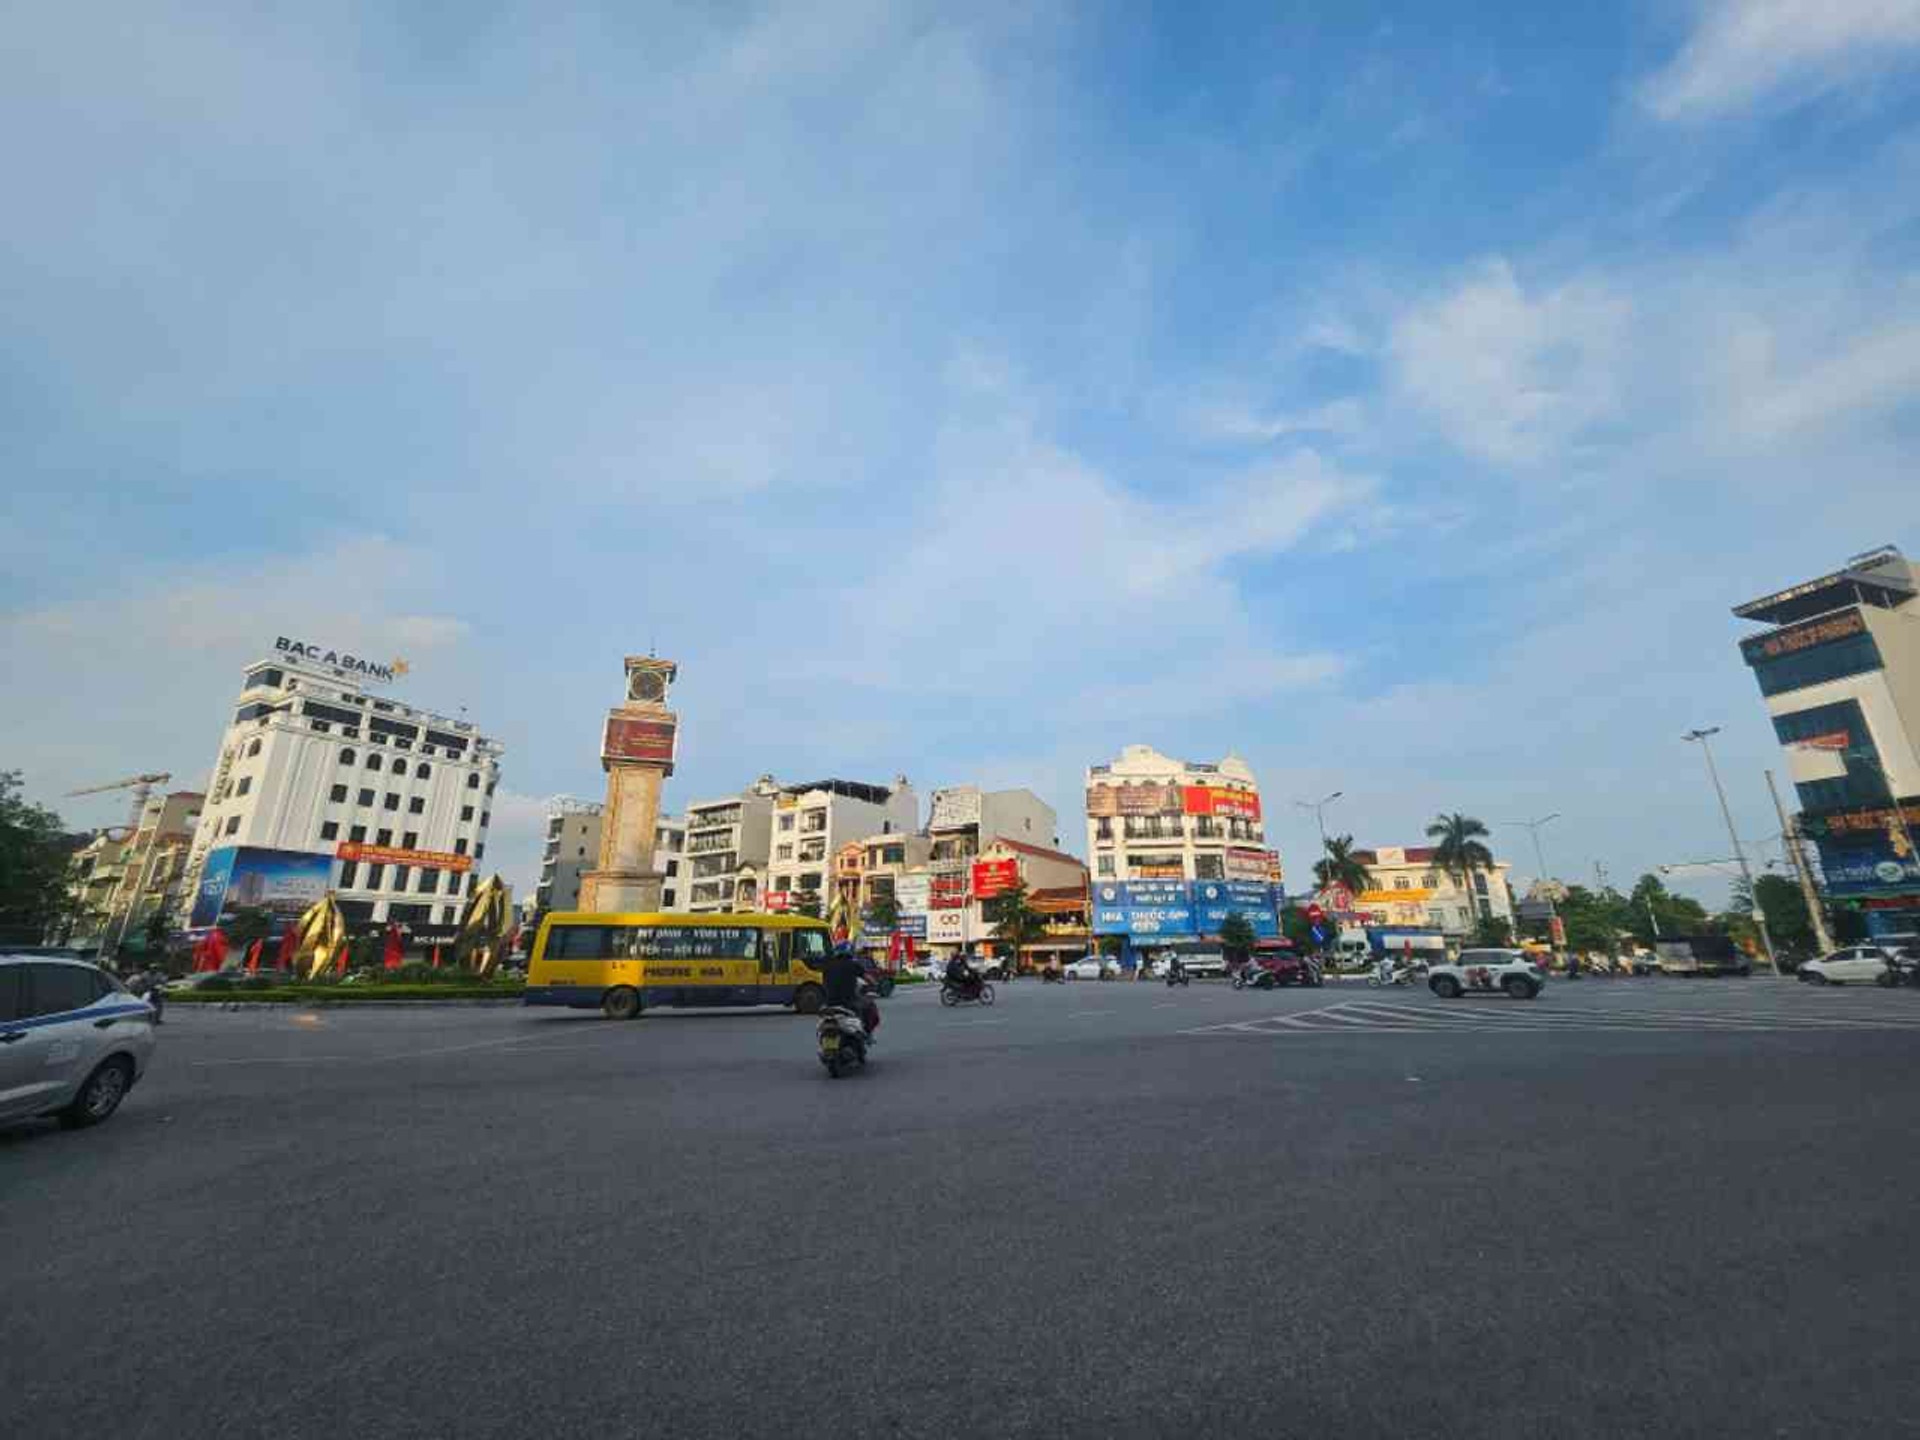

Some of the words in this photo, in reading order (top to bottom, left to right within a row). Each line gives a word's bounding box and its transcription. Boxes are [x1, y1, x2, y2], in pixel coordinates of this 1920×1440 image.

[275, 635, 321, 660] BAC
[322, 650, 338, 665] A
[341, 654, 394, 682] BANK
